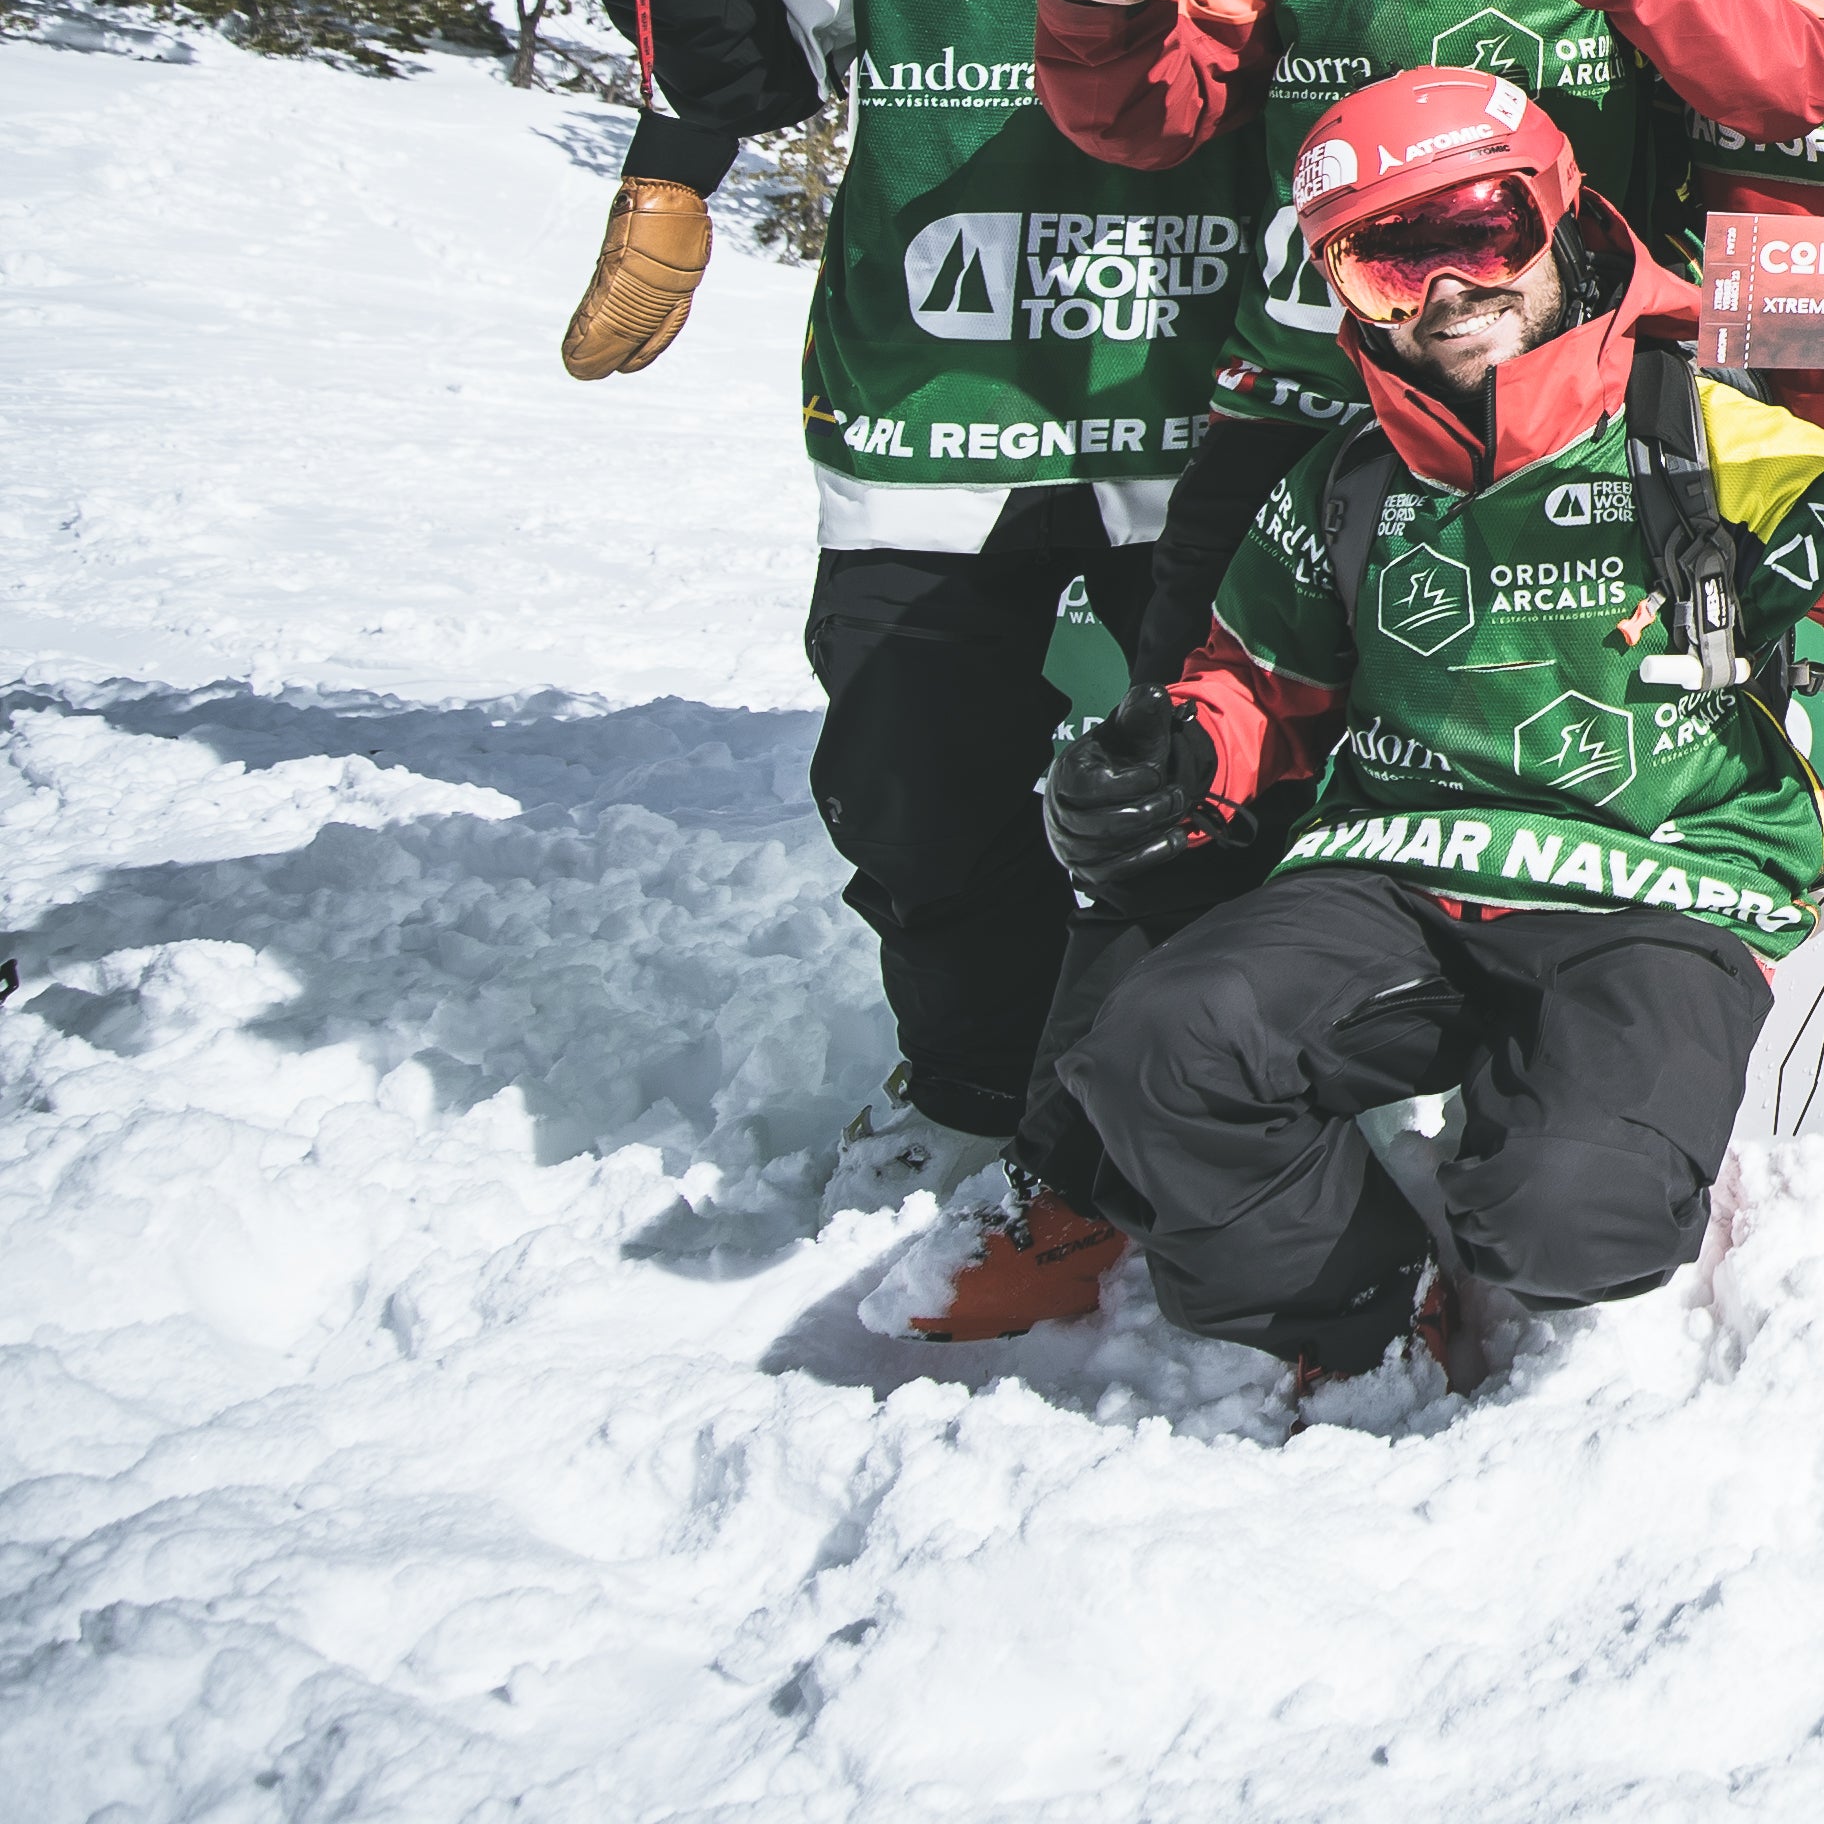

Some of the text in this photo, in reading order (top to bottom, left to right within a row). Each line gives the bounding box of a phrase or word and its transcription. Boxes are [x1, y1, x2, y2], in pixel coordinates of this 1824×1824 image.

[1300, 142, 1326, 171] THE
[1405, 124, 1494, 163] ATOMIC
[1027, 213, 1250, 256] FREERIDE
[1029, 256, 1228, 297] WORLD
[1021, 298, 1180, 341] TOUR
[930, 417, 1145, 459] REGNER
[1490, 556, 1625, 588] ORDINO
[1490, 577, 1627, 616] ARCALÍS
[1704, 578, 1721, 628] ABS
[1285, 815, 1494, 872] AYMAR
